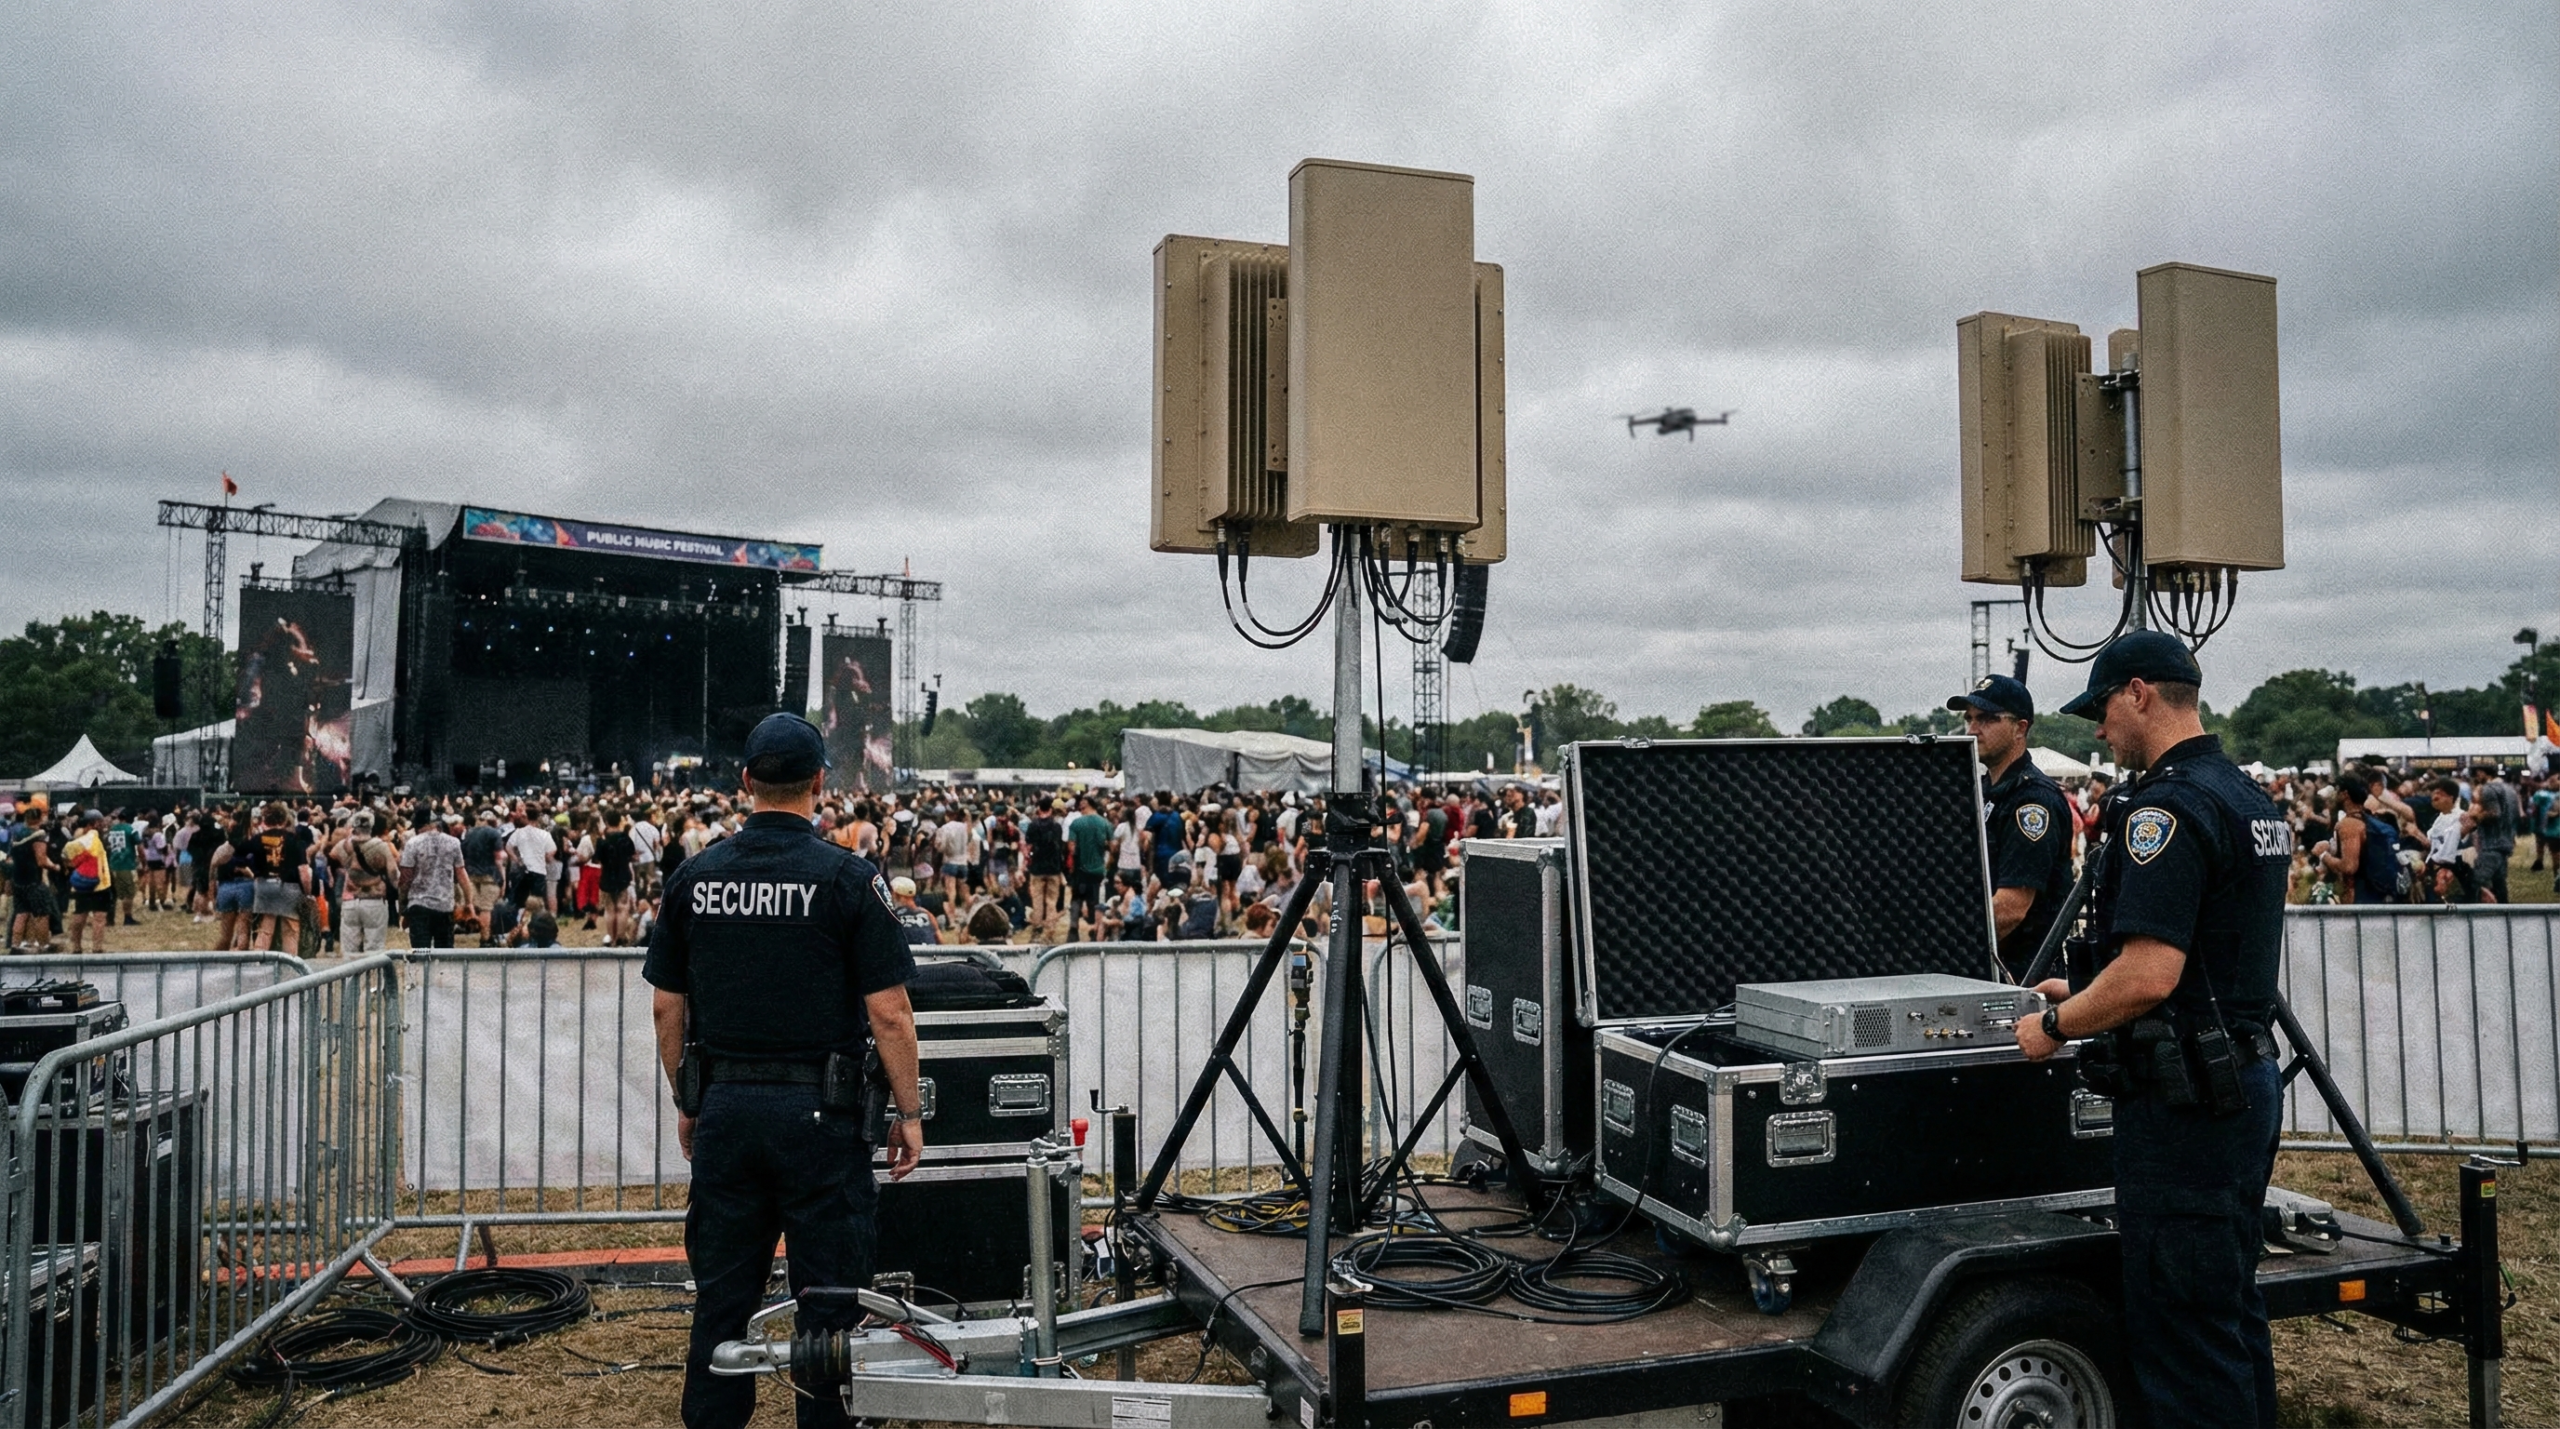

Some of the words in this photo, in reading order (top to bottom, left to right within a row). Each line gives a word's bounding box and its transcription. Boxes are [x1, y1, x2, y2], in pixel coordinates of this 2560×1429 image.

[587, 531, 632, 546] PUBLIC
[674, 541, 724, 556] FESTIVAL
[2251, 819, 2291, 856] SECURIT
[692, 881, 817, 917] SECURITY
